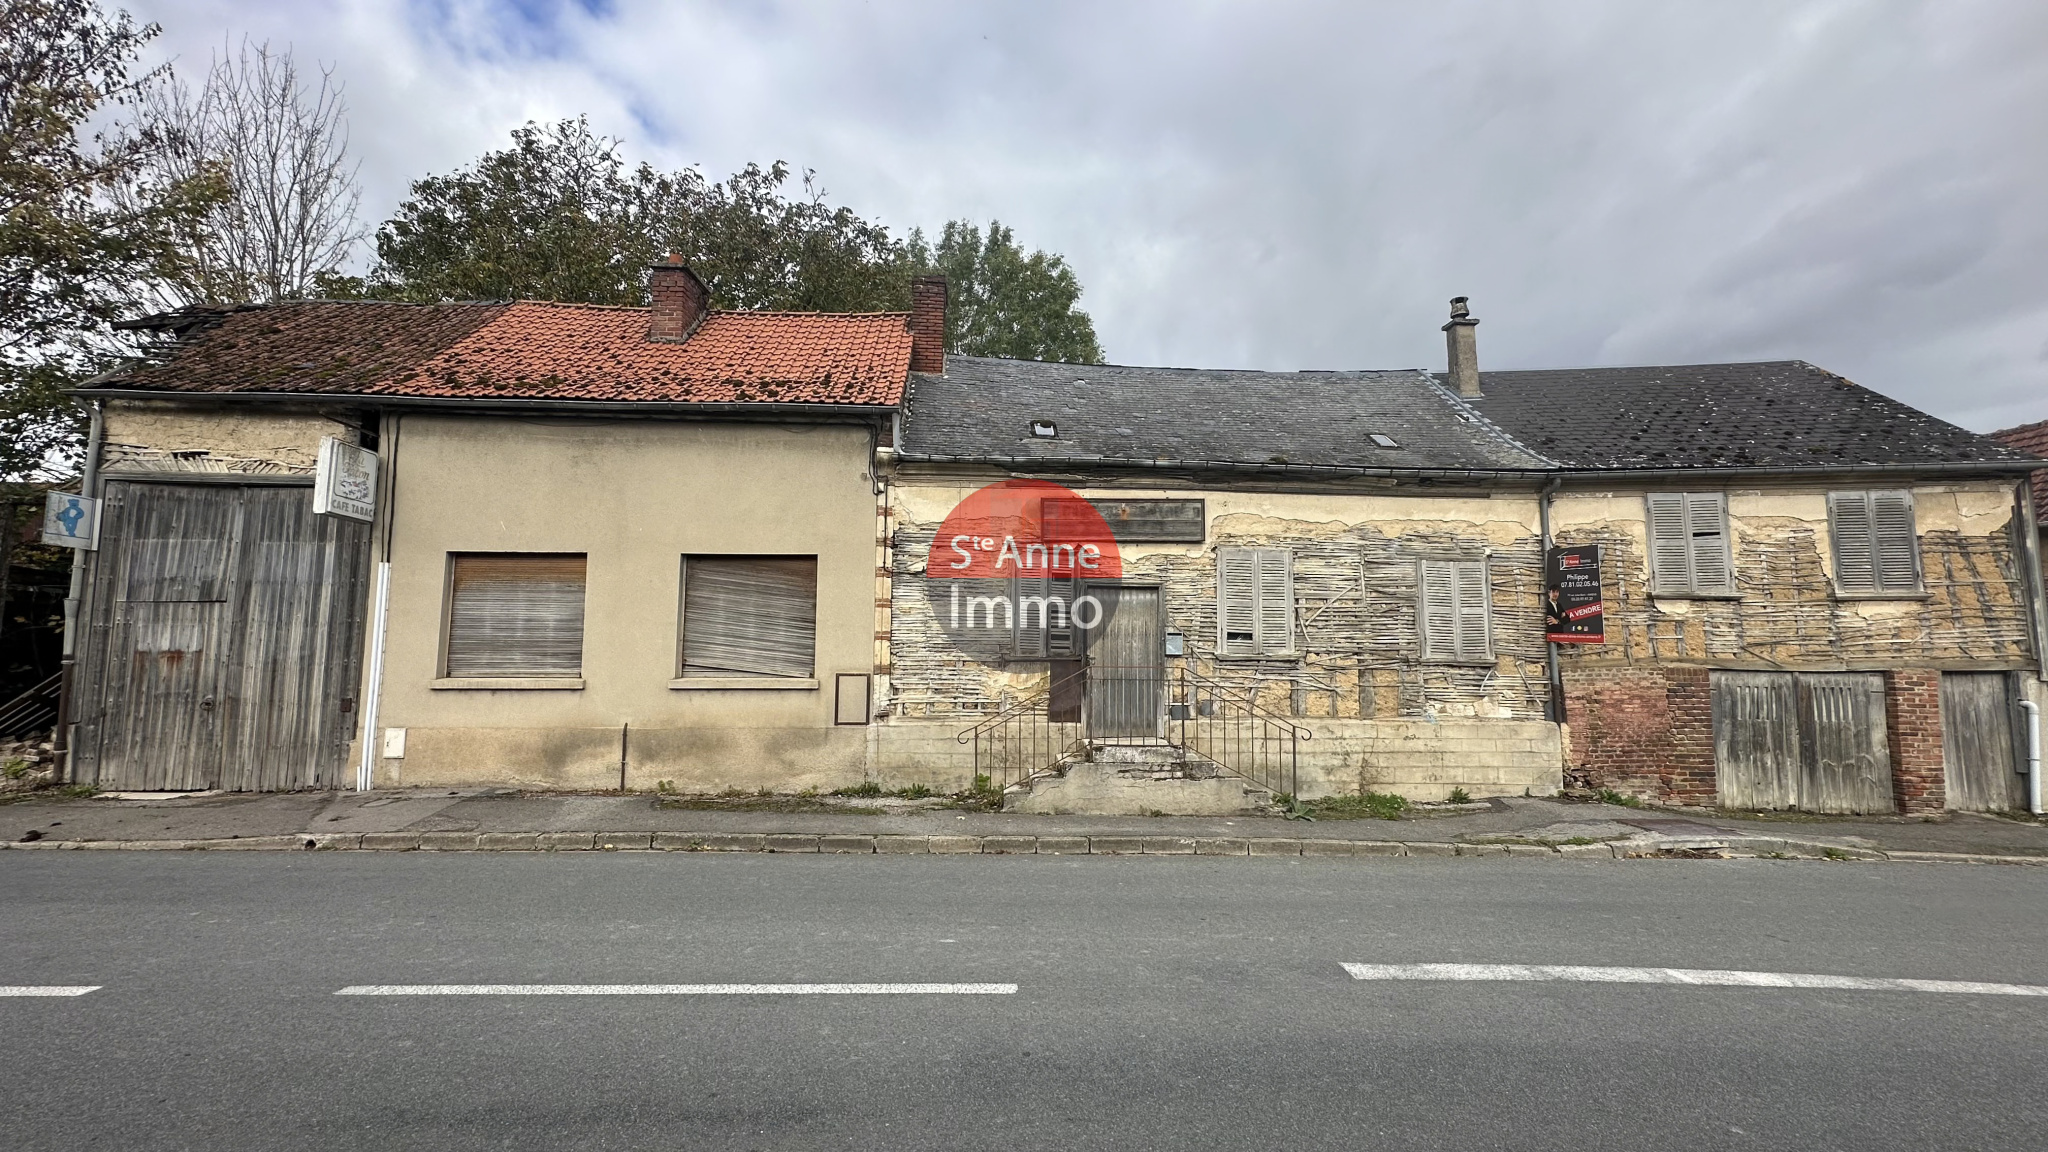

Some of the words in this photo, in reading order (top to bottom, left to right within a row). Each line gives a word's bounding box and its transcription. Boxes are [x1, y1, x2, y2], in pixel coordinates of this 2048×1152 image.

[332, 499, 349, 512] CAFE
[351, 503, 373, 517] TABAC
[1560, 580, 1599, 588] 07.81.02.05.46
[1569, 611, 1575, 619] A
[1574, 604, 1602, 617] VENDRE
